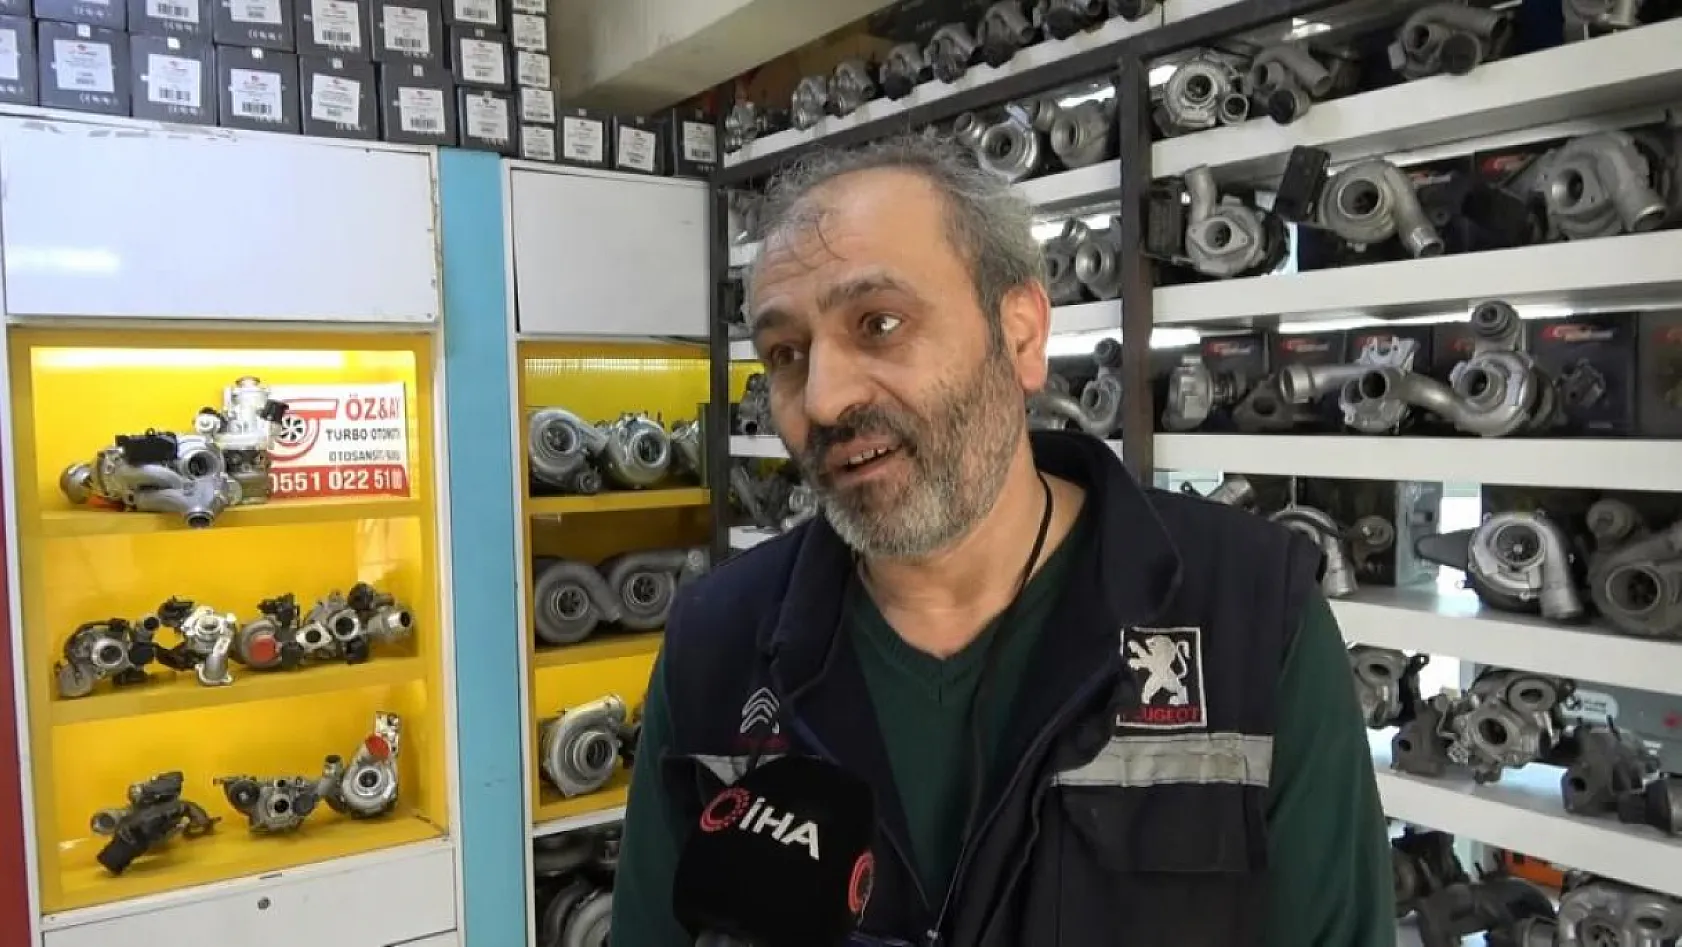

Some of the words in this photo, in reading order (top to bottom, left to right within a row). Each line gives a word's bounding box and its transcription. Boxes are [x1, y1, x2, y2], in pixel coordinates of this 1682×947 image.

[326, 428, 368, 441] TURBO
[268, 471, 321, 493] 0551
[328, 469, 370, 490] 022
[1122, 707, 1200, 721] UGEOT
[740, 797, 819, 860] İHA
